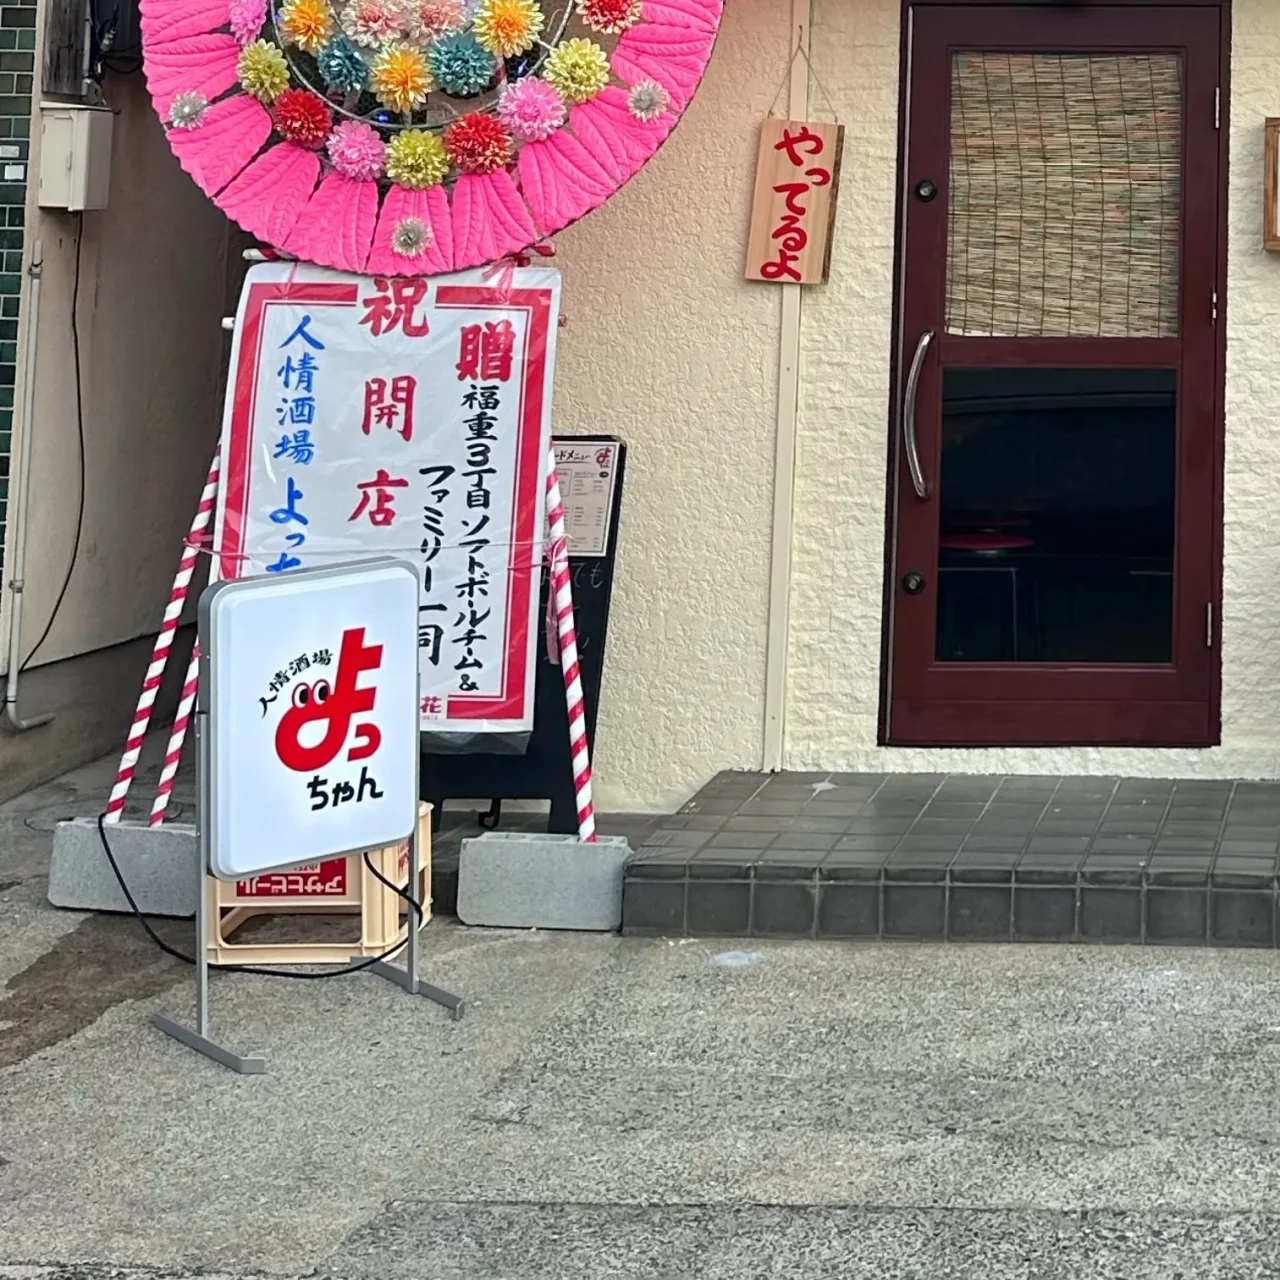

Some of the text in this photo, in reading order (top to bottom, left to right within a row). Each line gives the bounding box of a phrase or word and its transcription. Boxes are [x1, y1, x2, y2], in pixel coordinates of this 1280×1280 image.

[760, 126, 830, 281] やってるよ
[257, 648, 333, 719] 人情酒場
[239, 875, 343, 894] アサヒビール
